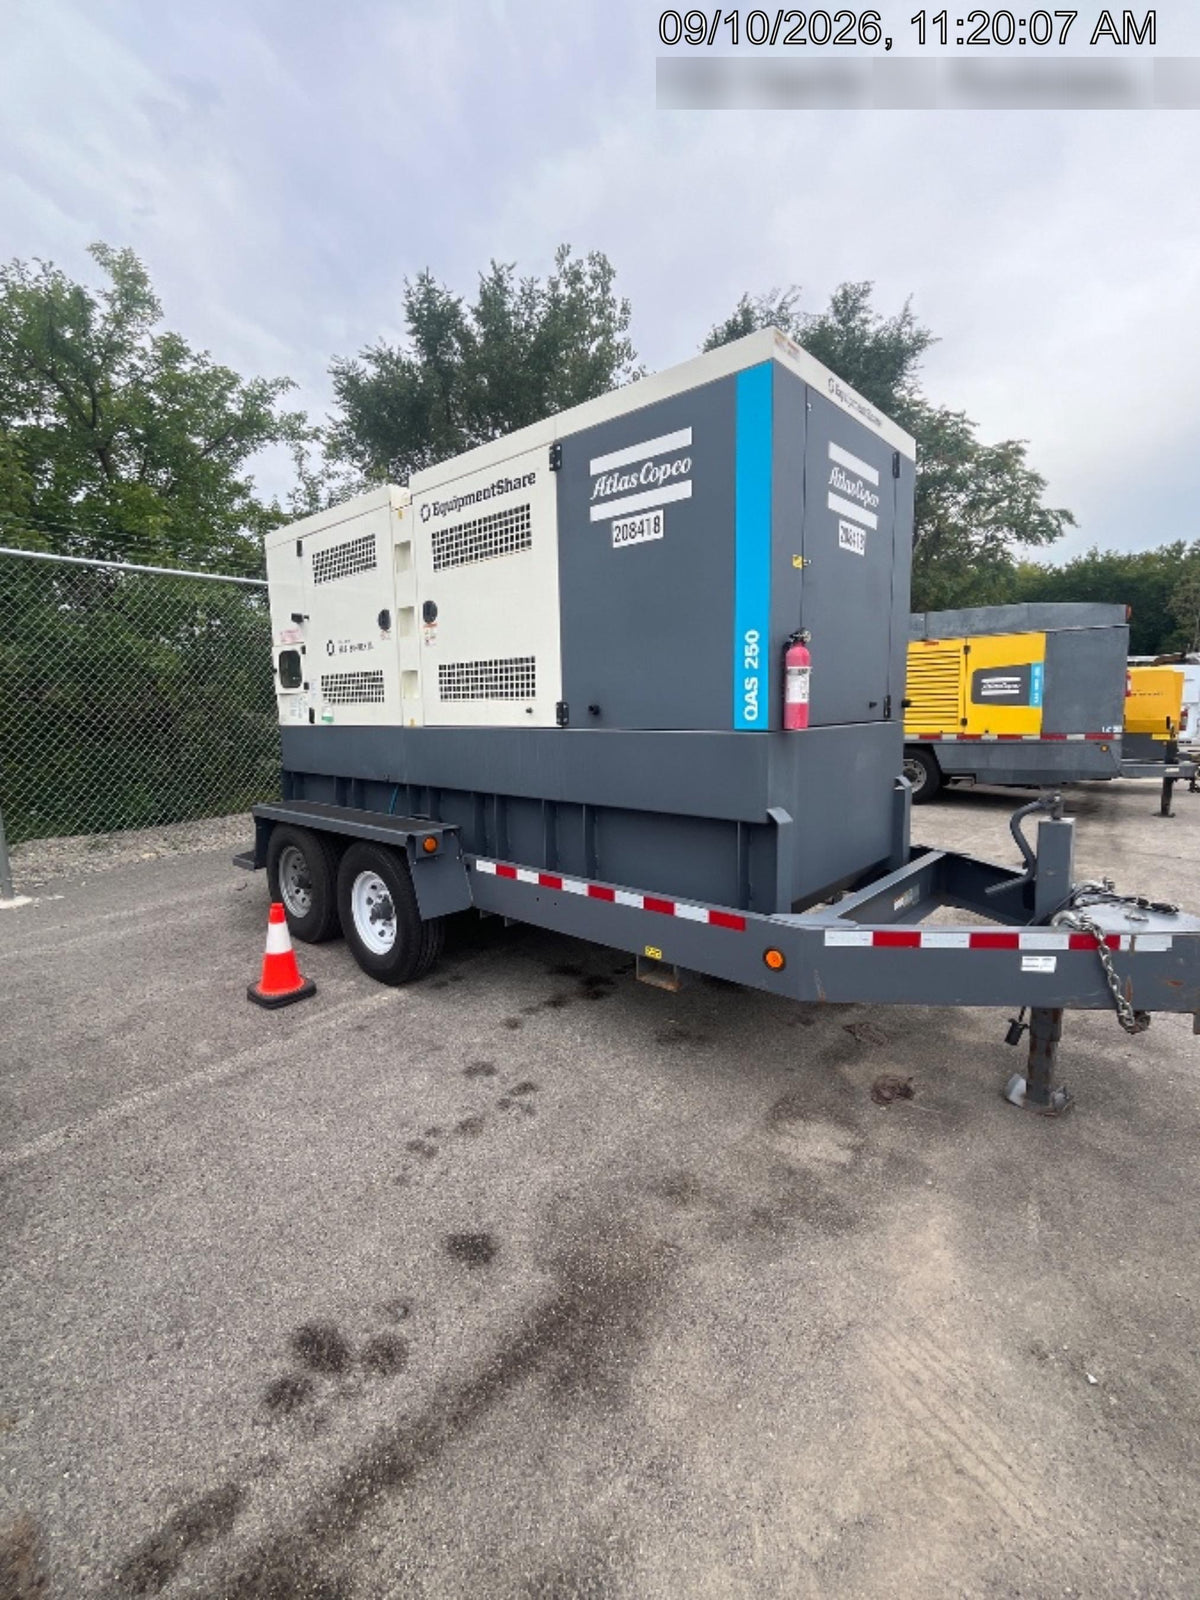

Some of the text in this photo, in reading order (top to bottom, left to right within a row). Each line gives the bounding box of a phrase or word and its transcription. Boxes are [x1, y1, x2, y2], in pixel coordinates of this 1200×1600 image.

[432, 472, 536, 518] EquipmentShare
[614, 515, 660, 543] 208418
[744, 629, 760, 670] 250
